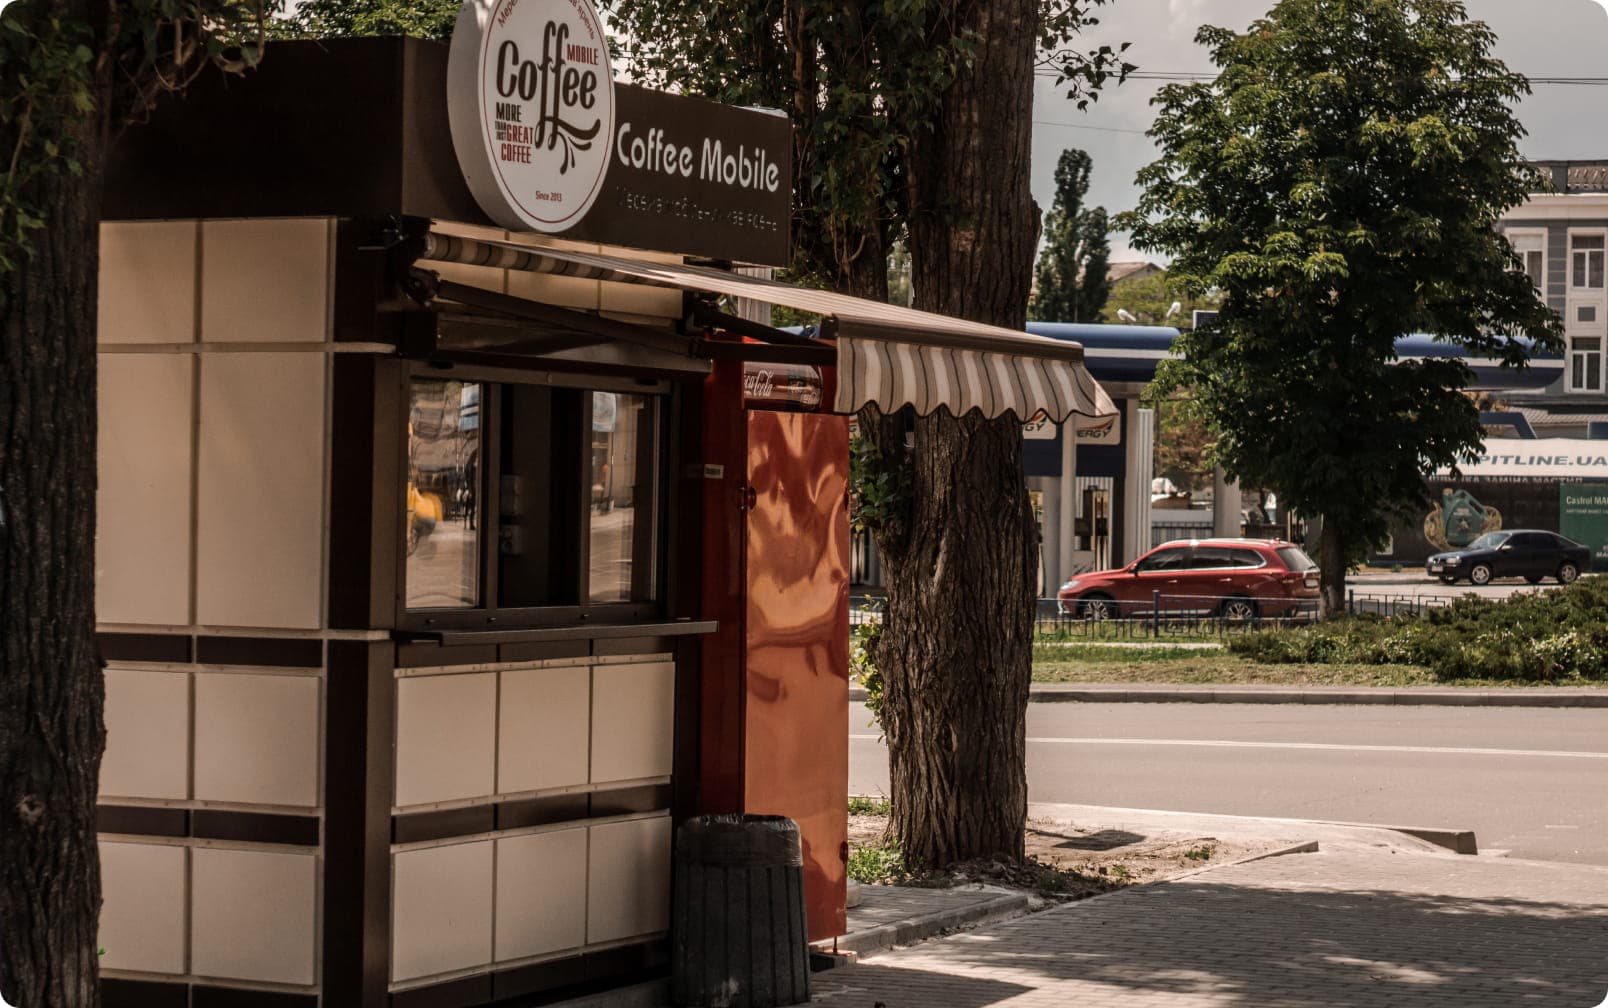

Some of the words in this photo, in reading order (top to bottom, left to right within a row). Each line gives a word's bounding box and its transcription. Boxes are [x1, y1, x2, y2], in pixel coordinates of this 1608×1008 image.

[567, 44, 599, 66] MOBILE
[496, 20, 598, 150] Coffee
[496, 102, 522, 123] MORE
[506, 123, 535, 145] GREAT
[501, 143, 533, 165] COFFEE
[617, 122, 693, 177] Coffee
[700, 137, 780, 193] Mobile
[535, 190, 550, 201] Since
[550, 192, 563, 202] 2013
[1566, 496, 1593, 505] Castrol
